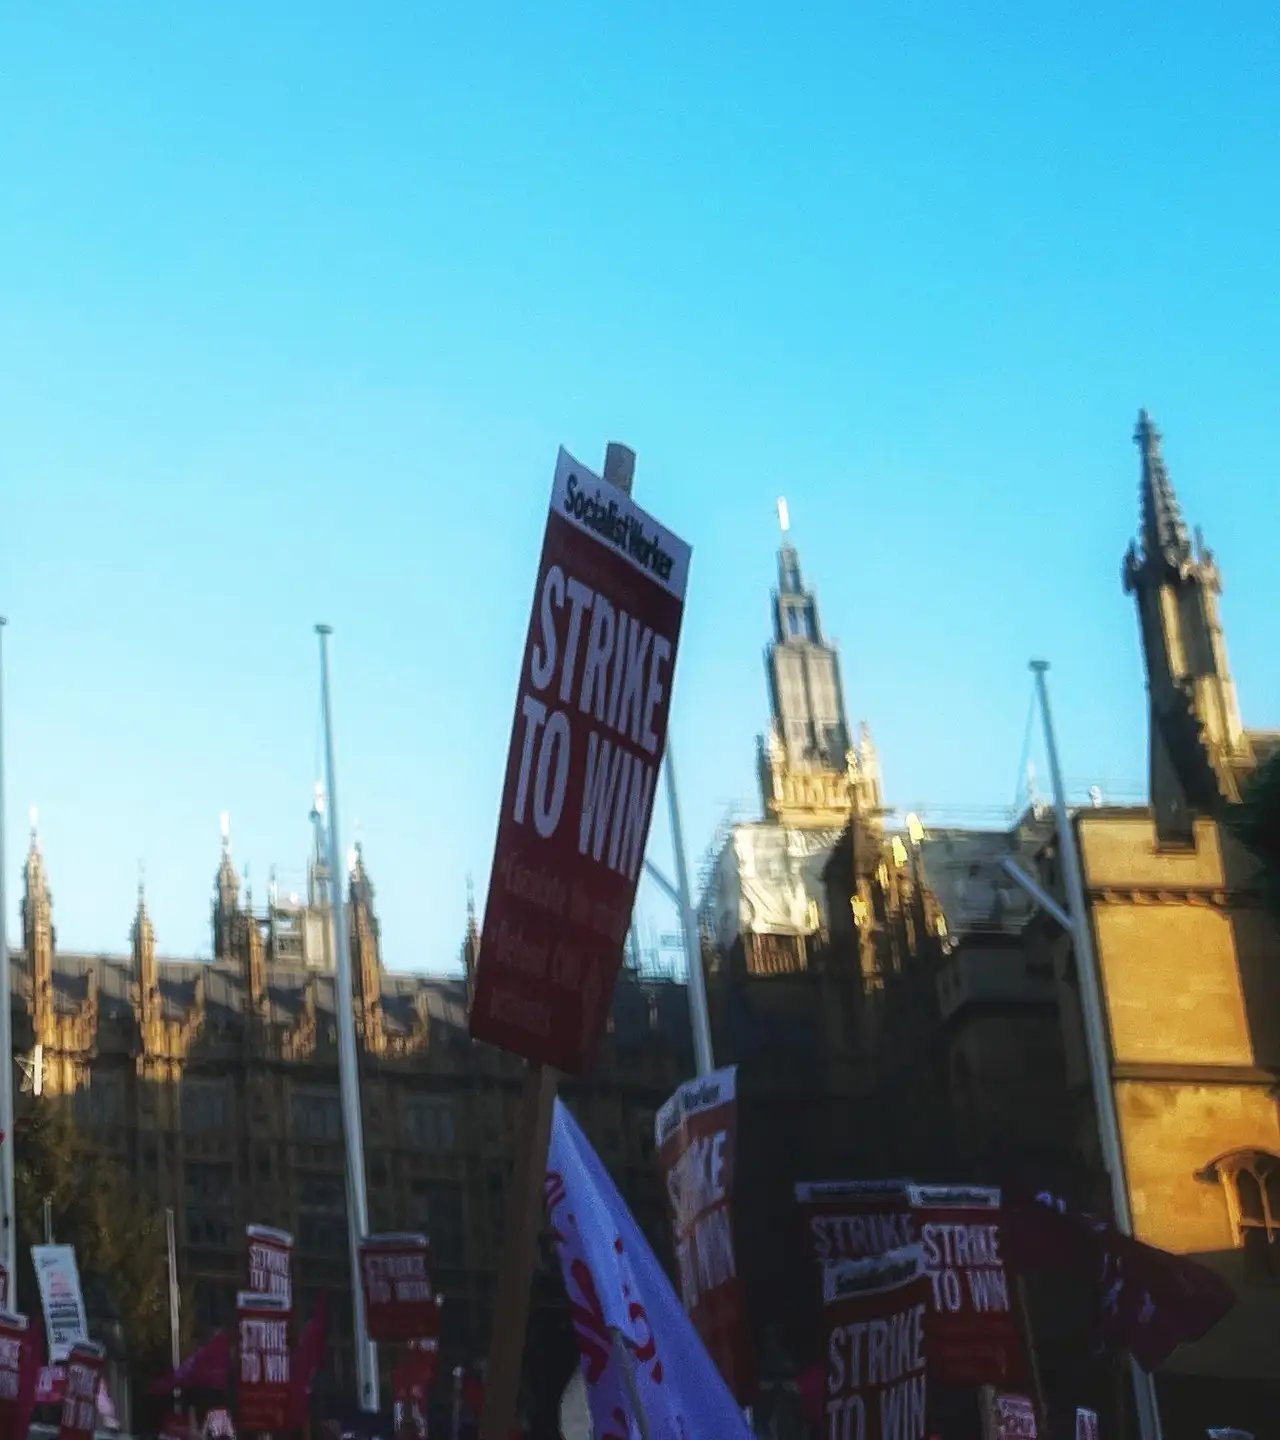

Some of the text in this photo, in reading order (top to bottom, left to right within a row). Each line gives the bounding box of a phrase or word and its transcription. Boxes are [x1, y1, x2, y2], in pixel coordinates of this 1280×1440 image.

[530, 564, 672, 755] STRIKE
[512, 695, 659, 883] TO WIN
[921, 1222, 1004, 1266] STRIKE
[923, 1267, 1012, 1313] TO WIN
[827, 1302, 927, 1394] STRIKE
